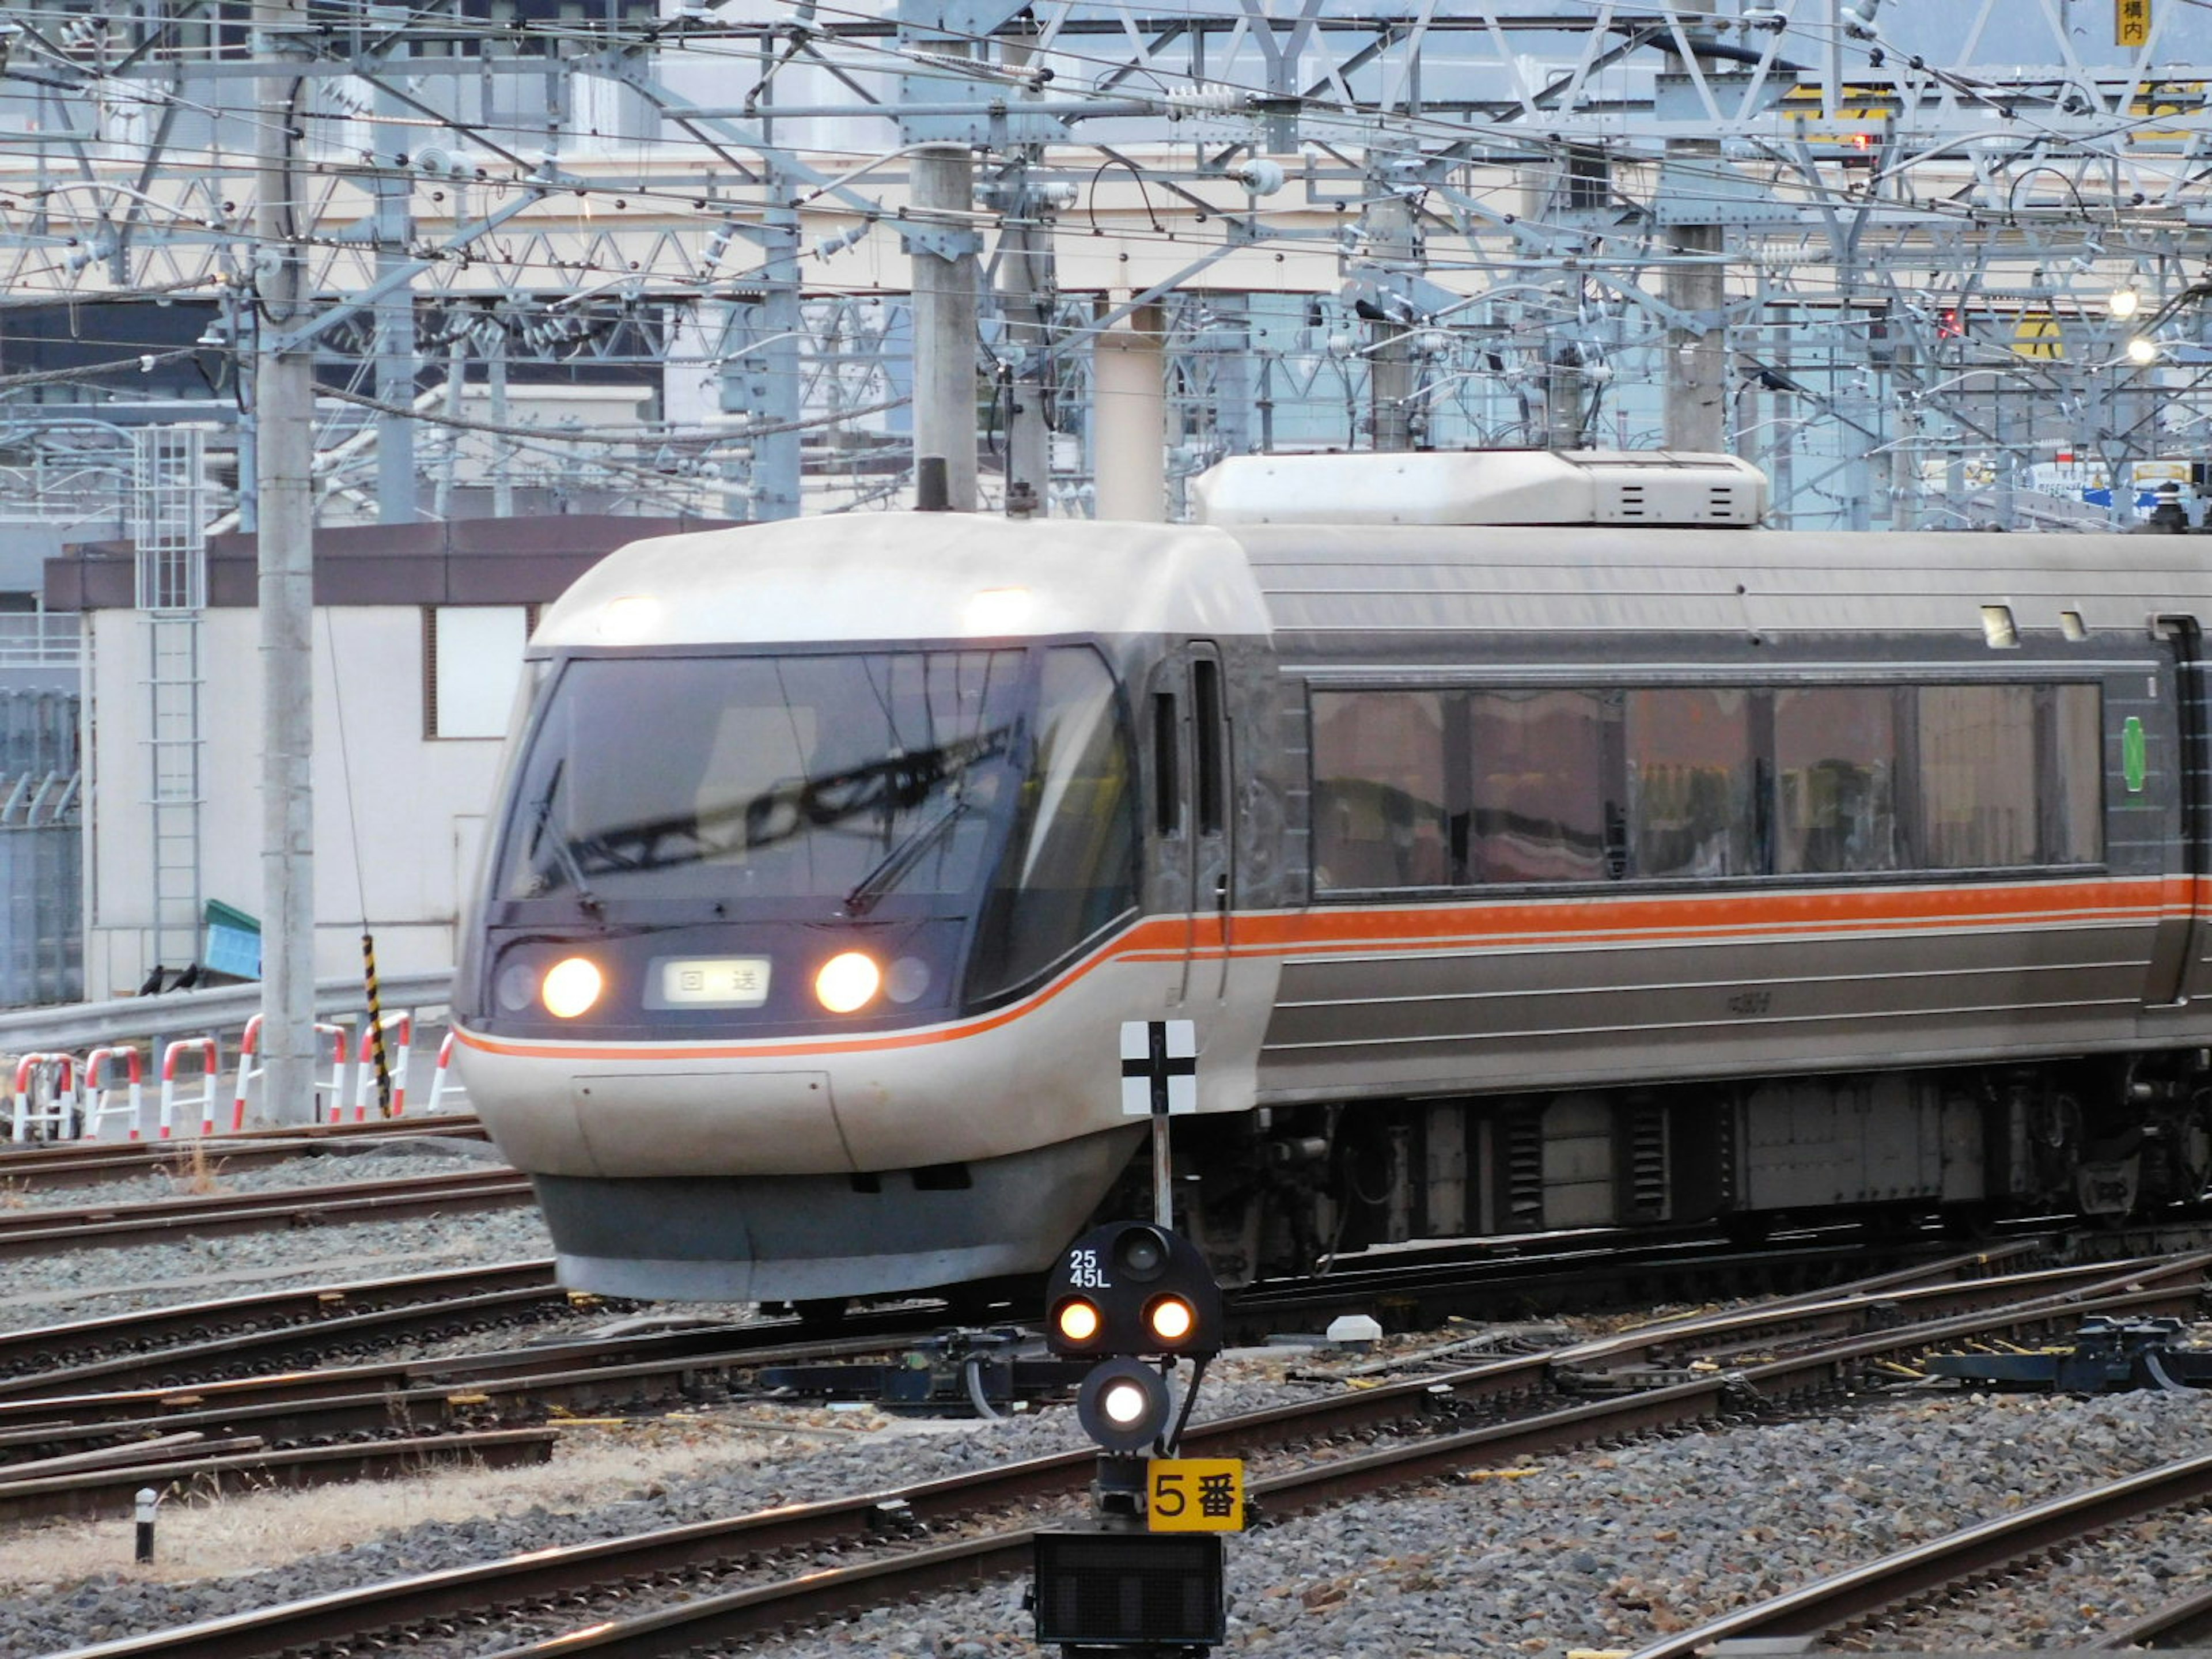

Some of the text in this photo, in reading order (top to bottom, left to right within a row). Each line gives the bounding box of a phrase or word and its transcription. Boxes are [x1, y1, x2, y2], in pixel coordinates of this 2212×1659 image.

[680, 969, 760, 991] 回送
[1070, 1249, 1097, 1269] 25
[1070, 1268, 1112, 1289] 45L
[1155, 1472, 1235, 1518] 5番
